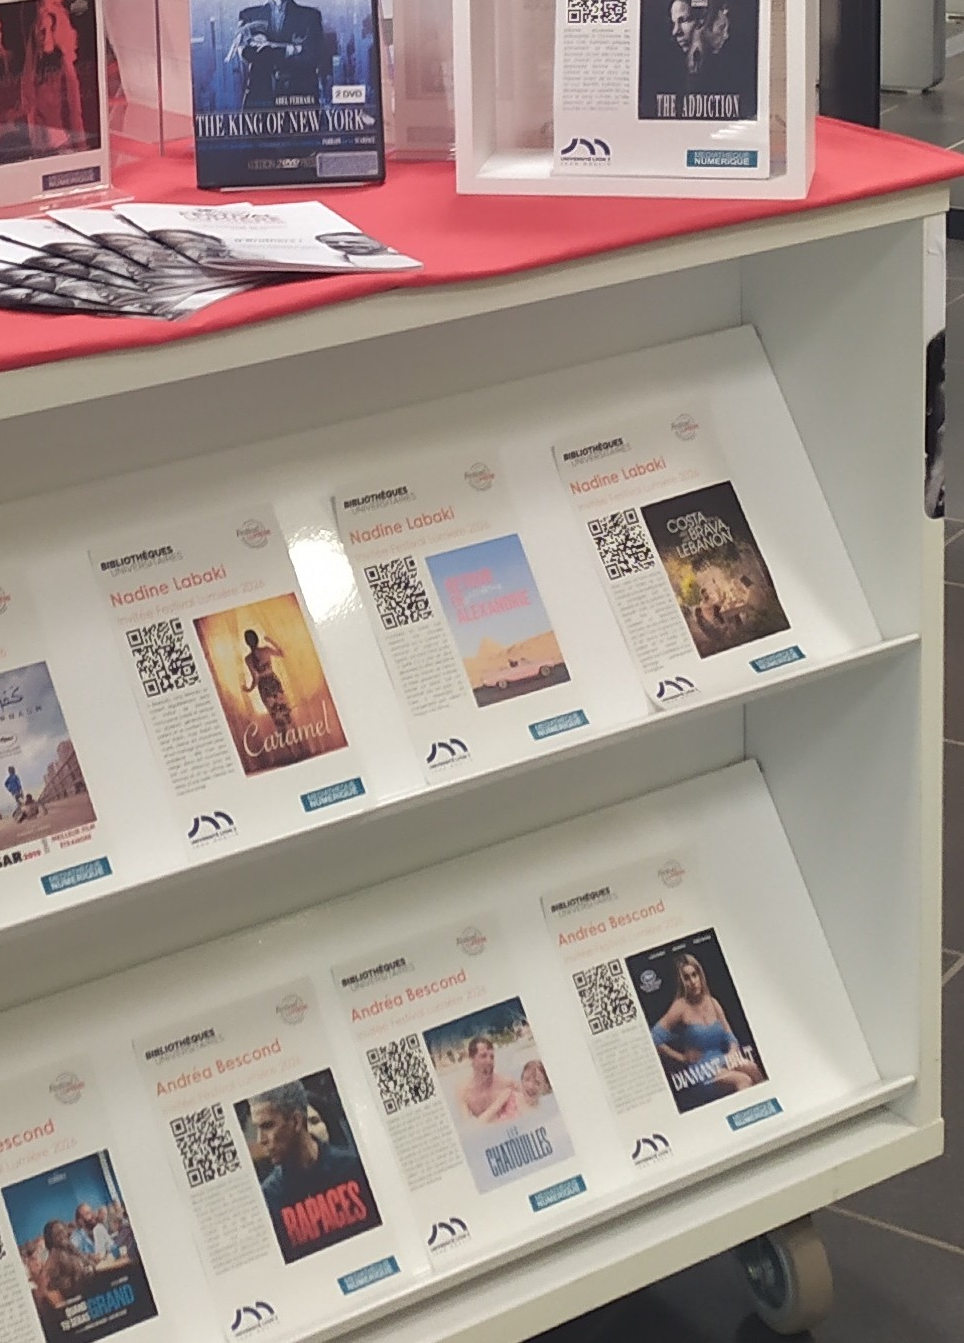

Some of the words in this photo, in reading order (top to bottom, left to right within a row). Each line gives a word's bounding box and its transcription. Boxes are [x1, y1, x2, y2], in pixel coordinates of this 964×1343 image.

[343, 90, 362, 99] DVD
[657, 94, 676, 117] THE
[682, 94, 740, 117] ADDICTION
[195, 114, 225, 138] THE
[229, 113, 264, 136] KING
[266, 113, 286, 134] OF
[289, 110, 322, 134] NEW
[325, 109, 364, 132] YORK
[570, 472, 619, 494] Nadine
[621, 456, 667, 480] Labaki
[349, 521, 403, 545] Nadine
[406, 506, 455, 530] Labaki
[667, 511, 708, 534] COSTA
[676, 530, 734, 558] LEBANON
[110, 583, 169, 608] Nadine
[173, 565, 227, 590] Labaki
[243, 702, 332, 758] Caramel
[558, 922, 607, 947] Andréa
[610, 900, 666, 929] Bescond
[351, 993, 404, 1023] Andréa
[406, 969, 467, 1002] Bescond
[157, 1067, 213, 1097] Andréa
[216, 1039, 282, 1074] Bescond
[281, 1179, 368, 1247] RAPACES
